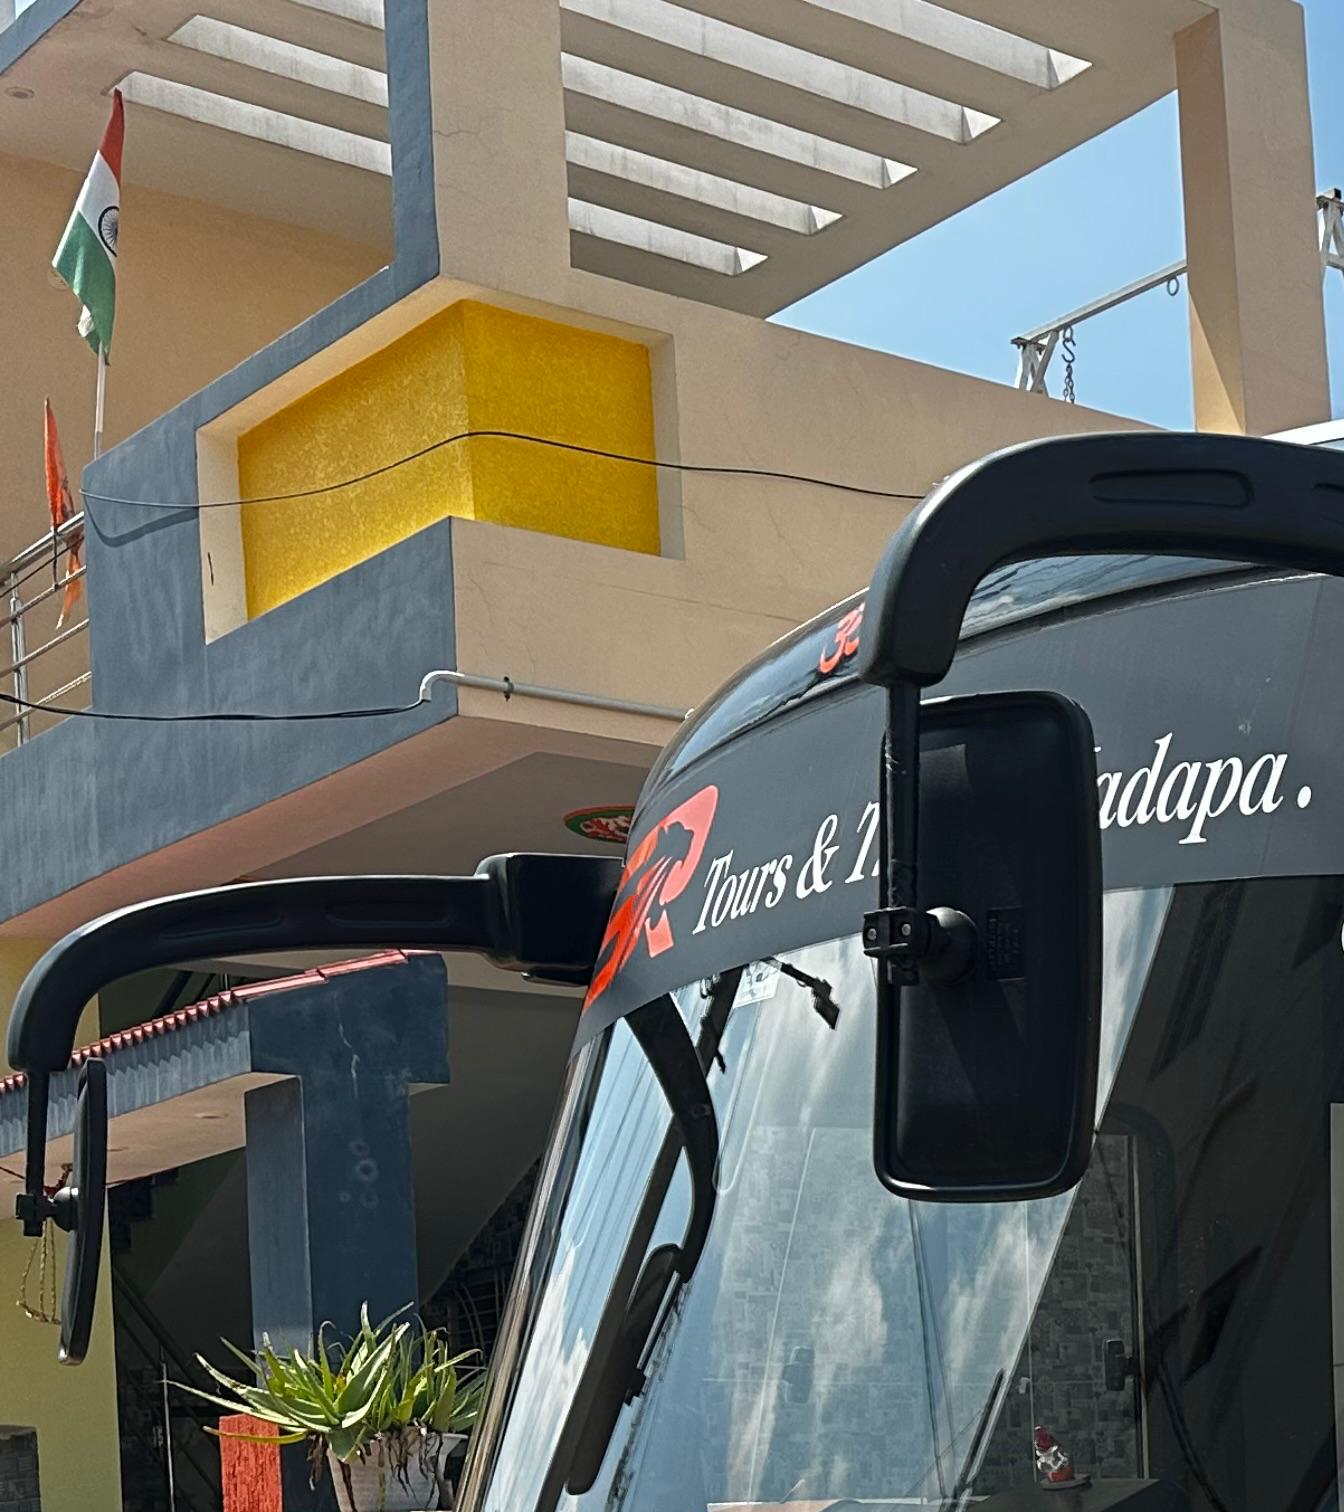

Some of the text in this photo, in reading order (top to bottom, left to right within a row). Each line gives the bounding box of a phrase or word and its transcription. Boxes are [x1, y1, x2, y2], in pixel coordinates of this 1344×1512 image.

[692, 849, 794, 935] Tours
[796, 814, 840, 899] &
[1094, 732, 1312, 845] adapa.
